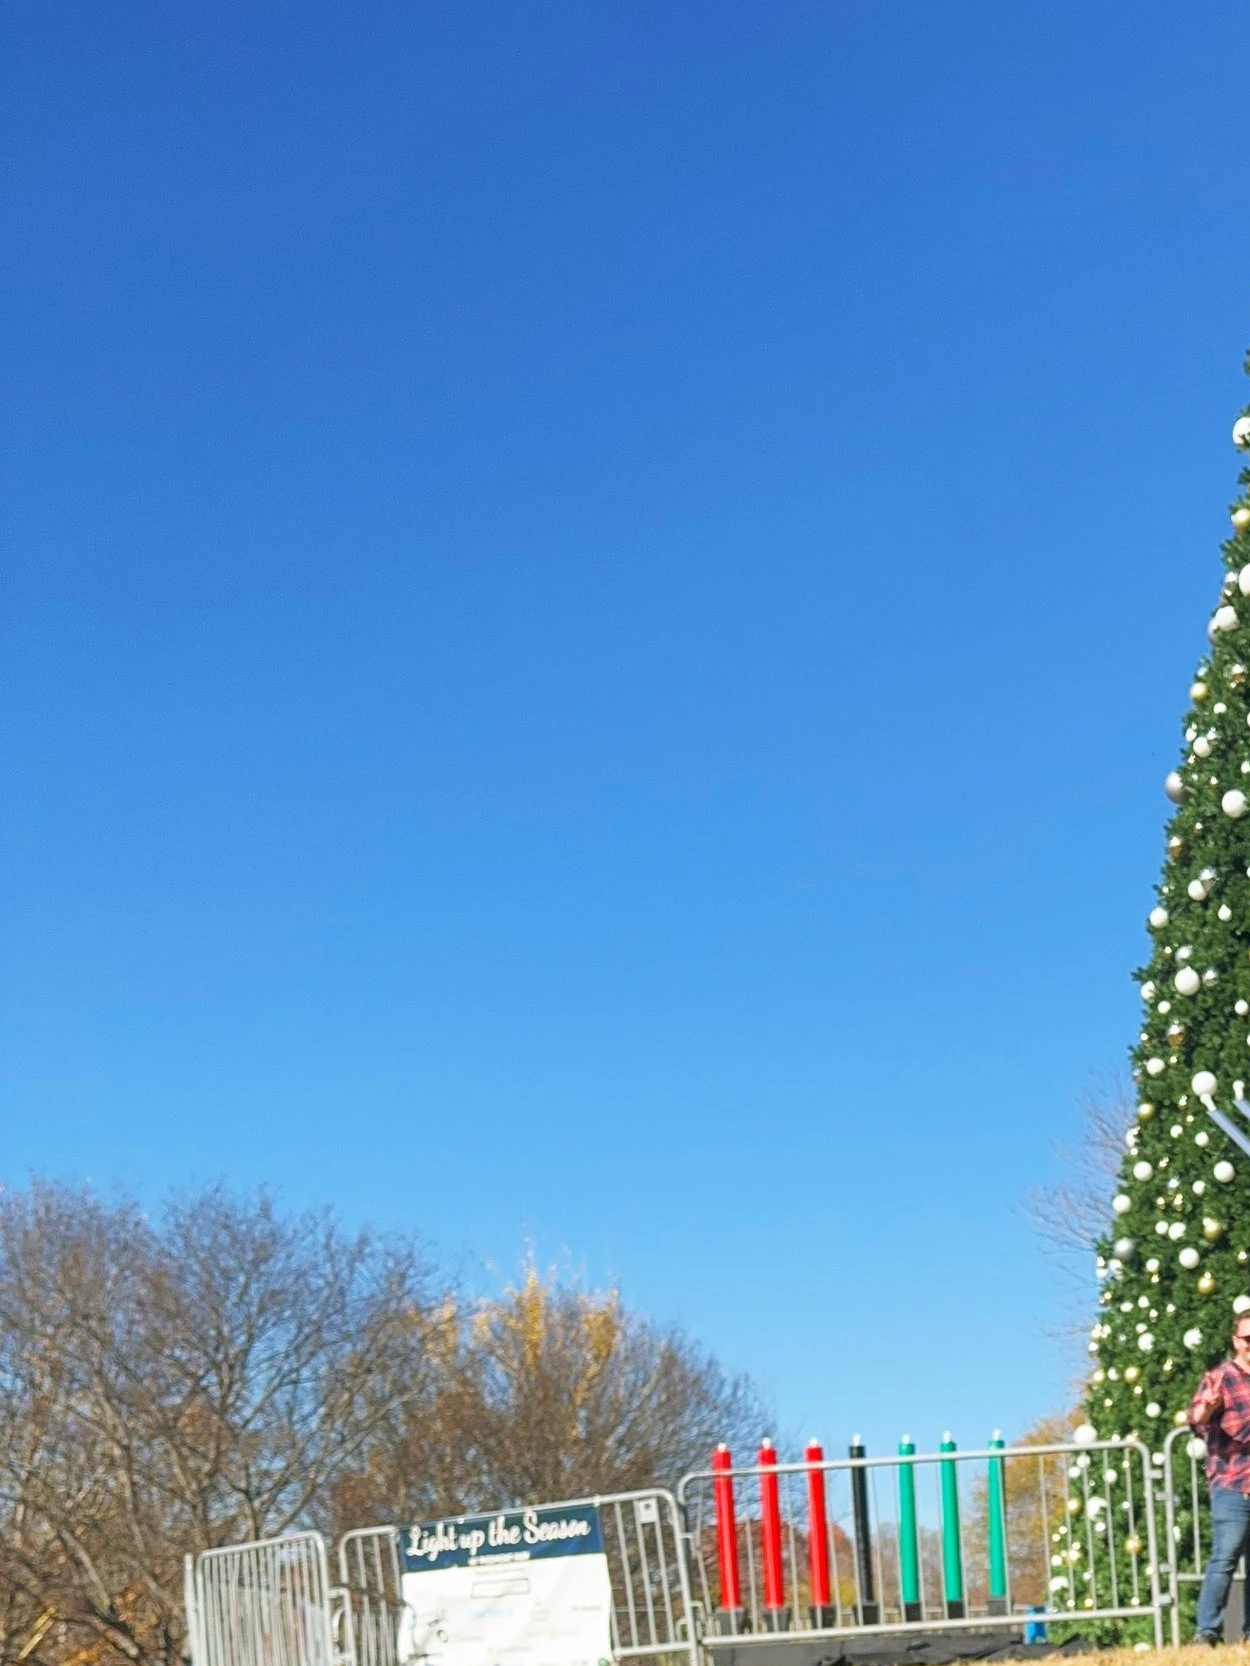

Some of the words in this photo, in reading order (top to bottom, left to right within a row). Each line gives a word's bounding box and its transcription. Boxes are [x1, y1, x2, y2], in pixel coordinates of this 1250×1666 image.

[407, 1522, 457, 1561] Light
[459, 1530, 485, 1554] up
[489, 1517, 521, 1546] the
[524, 1511, 591, 1544] Season
